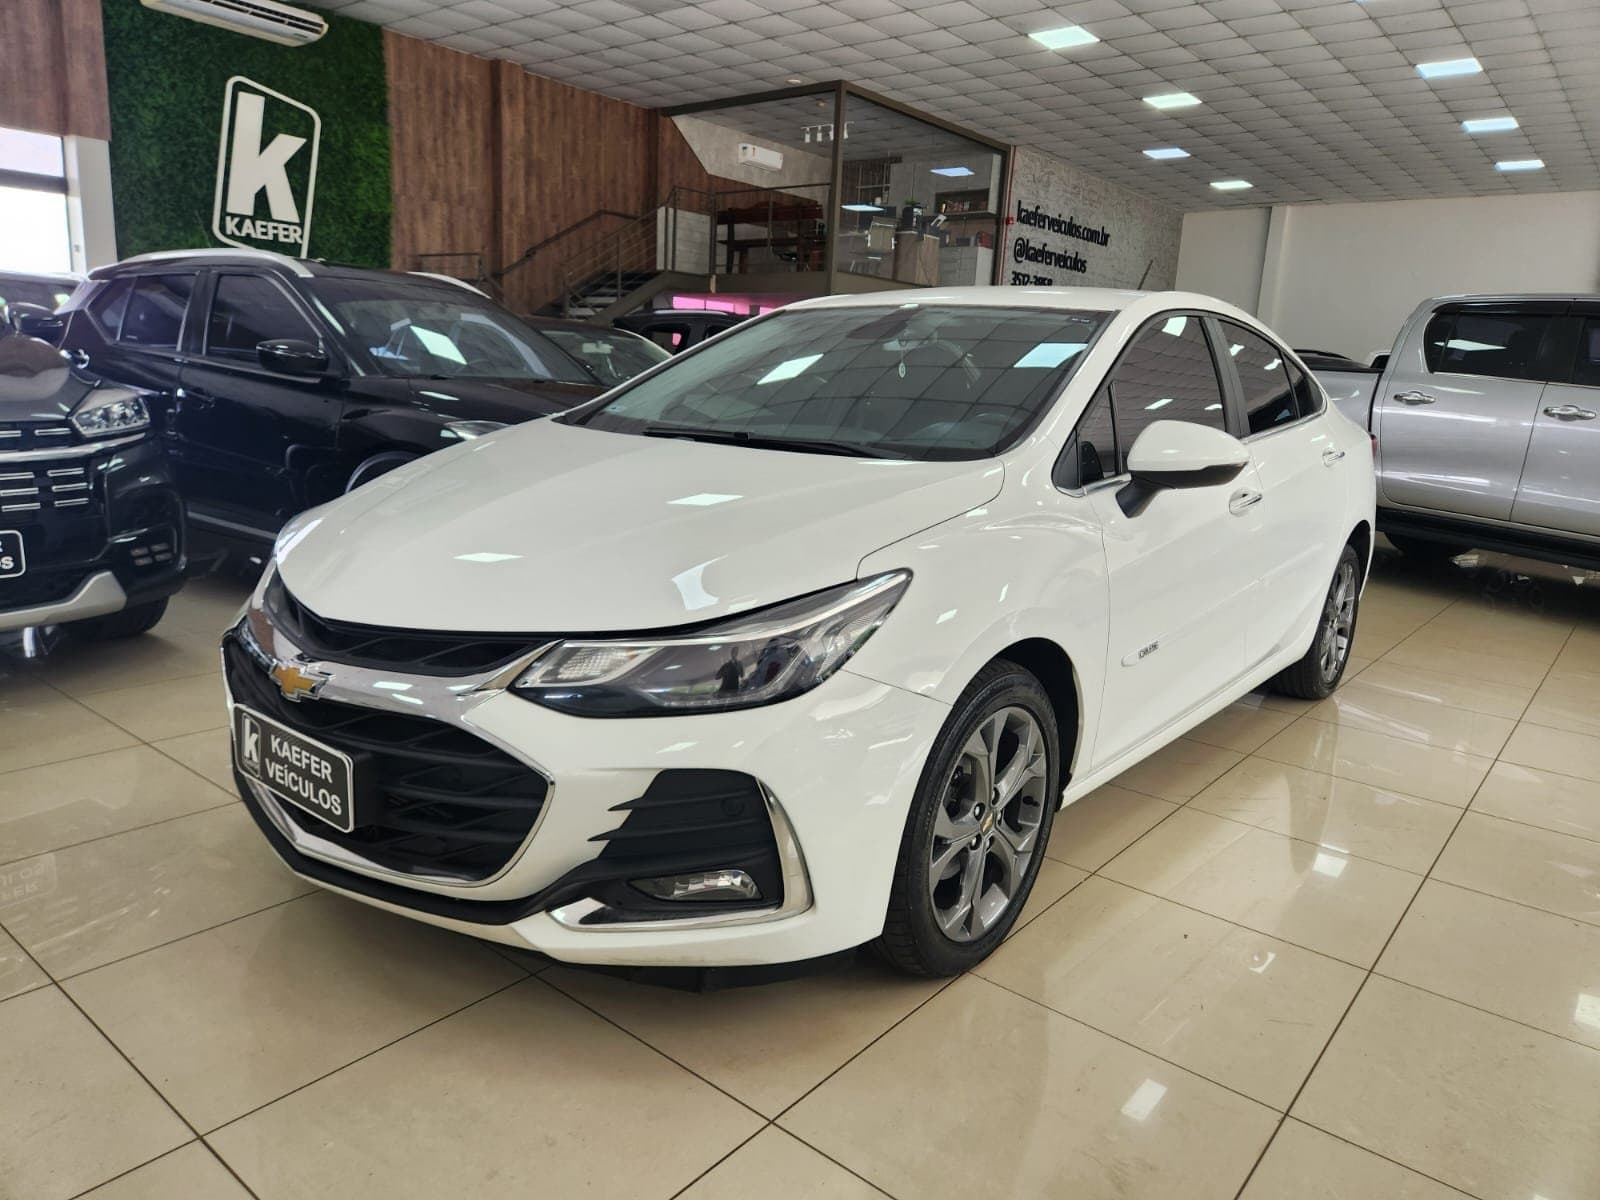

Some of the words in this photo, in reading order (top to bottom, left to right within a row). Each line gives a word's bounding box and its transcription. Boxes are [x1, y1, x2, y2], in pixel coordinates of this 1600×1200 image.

[225, 215, 303, 244] KAEFER
[1016, 199, 1110, 247] kaeferveiculos.com.br
[1013, 237, 1087, 273] @kaeferveiculos
[270, 734, 333, 783] KAEFER
[265, 757, 342, 816] VEÍCULOS
